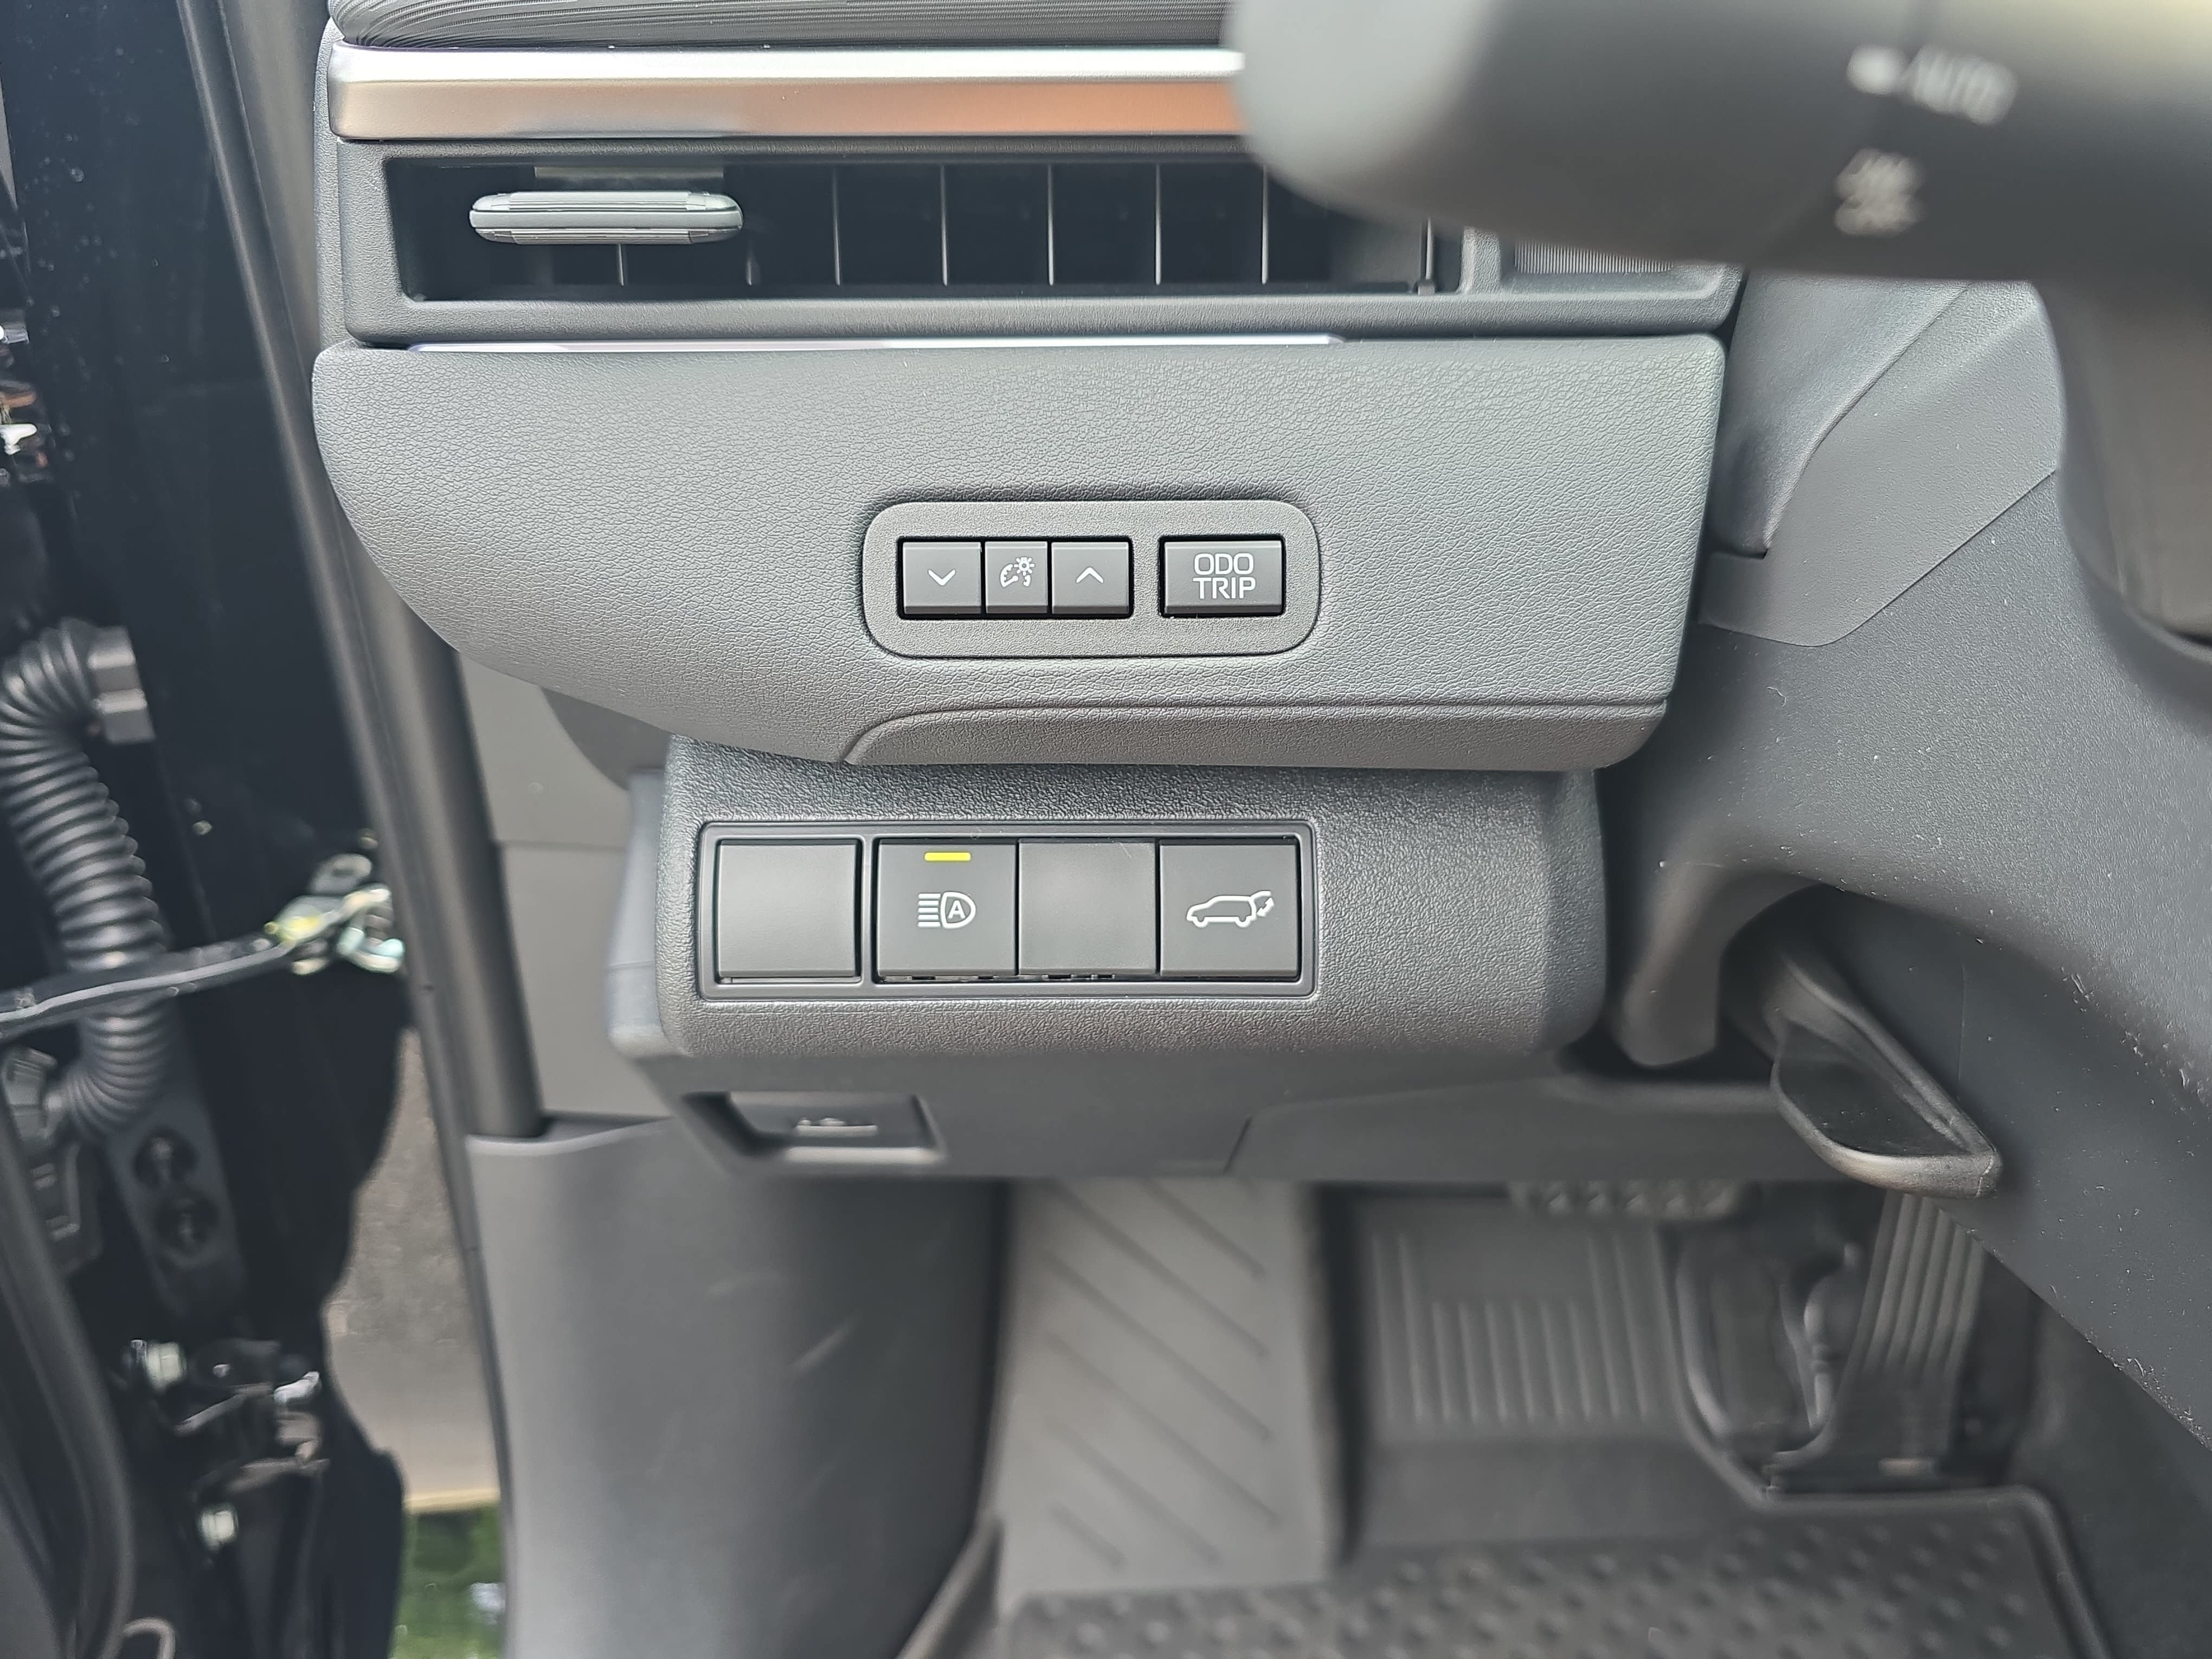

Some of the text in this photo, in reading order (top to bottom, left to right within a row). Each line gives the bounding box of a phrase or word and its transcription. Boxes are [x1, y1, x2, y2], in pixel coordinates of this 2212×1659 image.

[1194, 553, 1254, 575] ODO
[1193, 577, 1256, 599] TRIP
[948, 900, 966, 919] A
